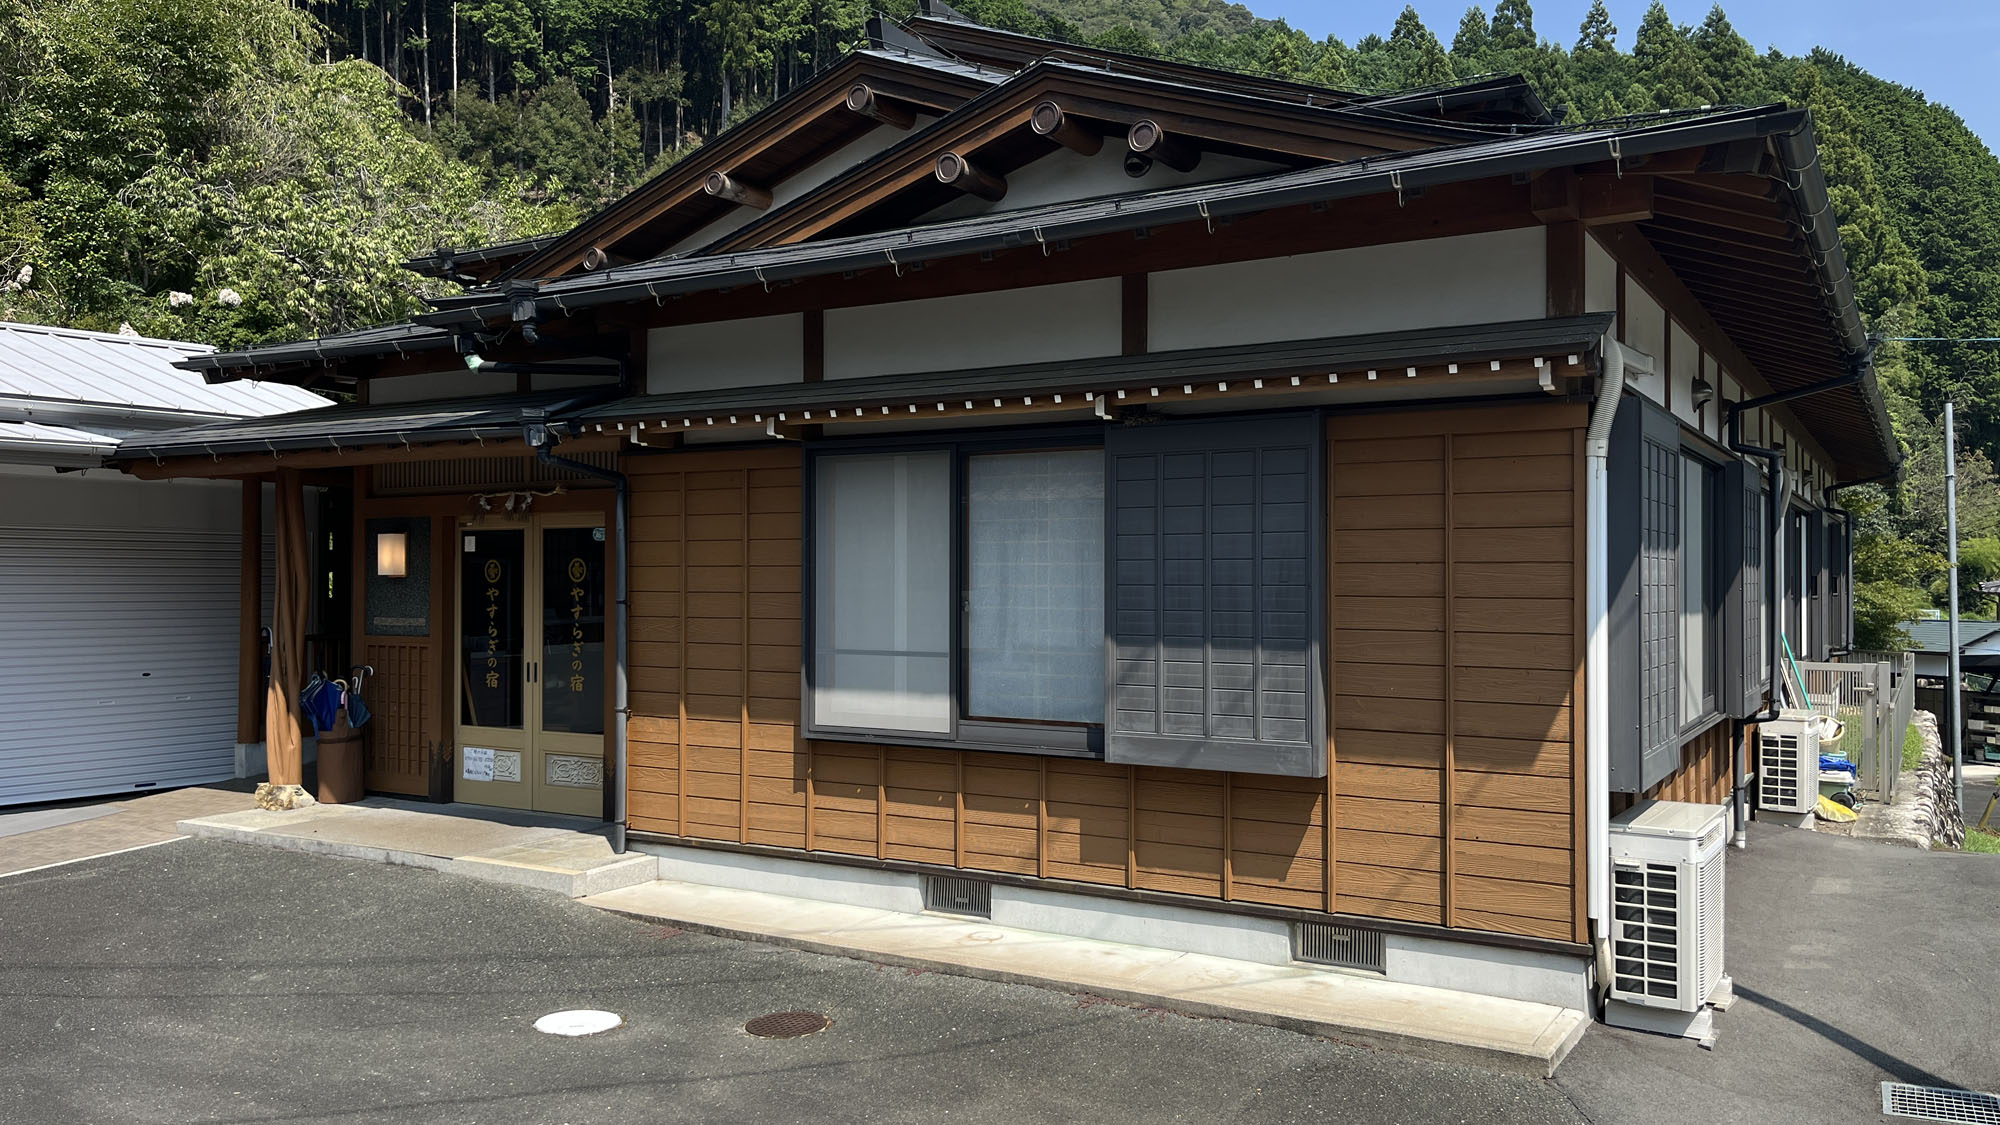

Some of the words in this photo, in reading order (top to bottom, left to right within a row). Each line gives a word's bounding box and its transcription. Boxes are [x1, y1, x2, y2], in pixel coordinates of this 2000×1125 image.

[486, 587, 500, 688] やすらぎの宿
[570, 587, 585, 692] やすらぎの宿
